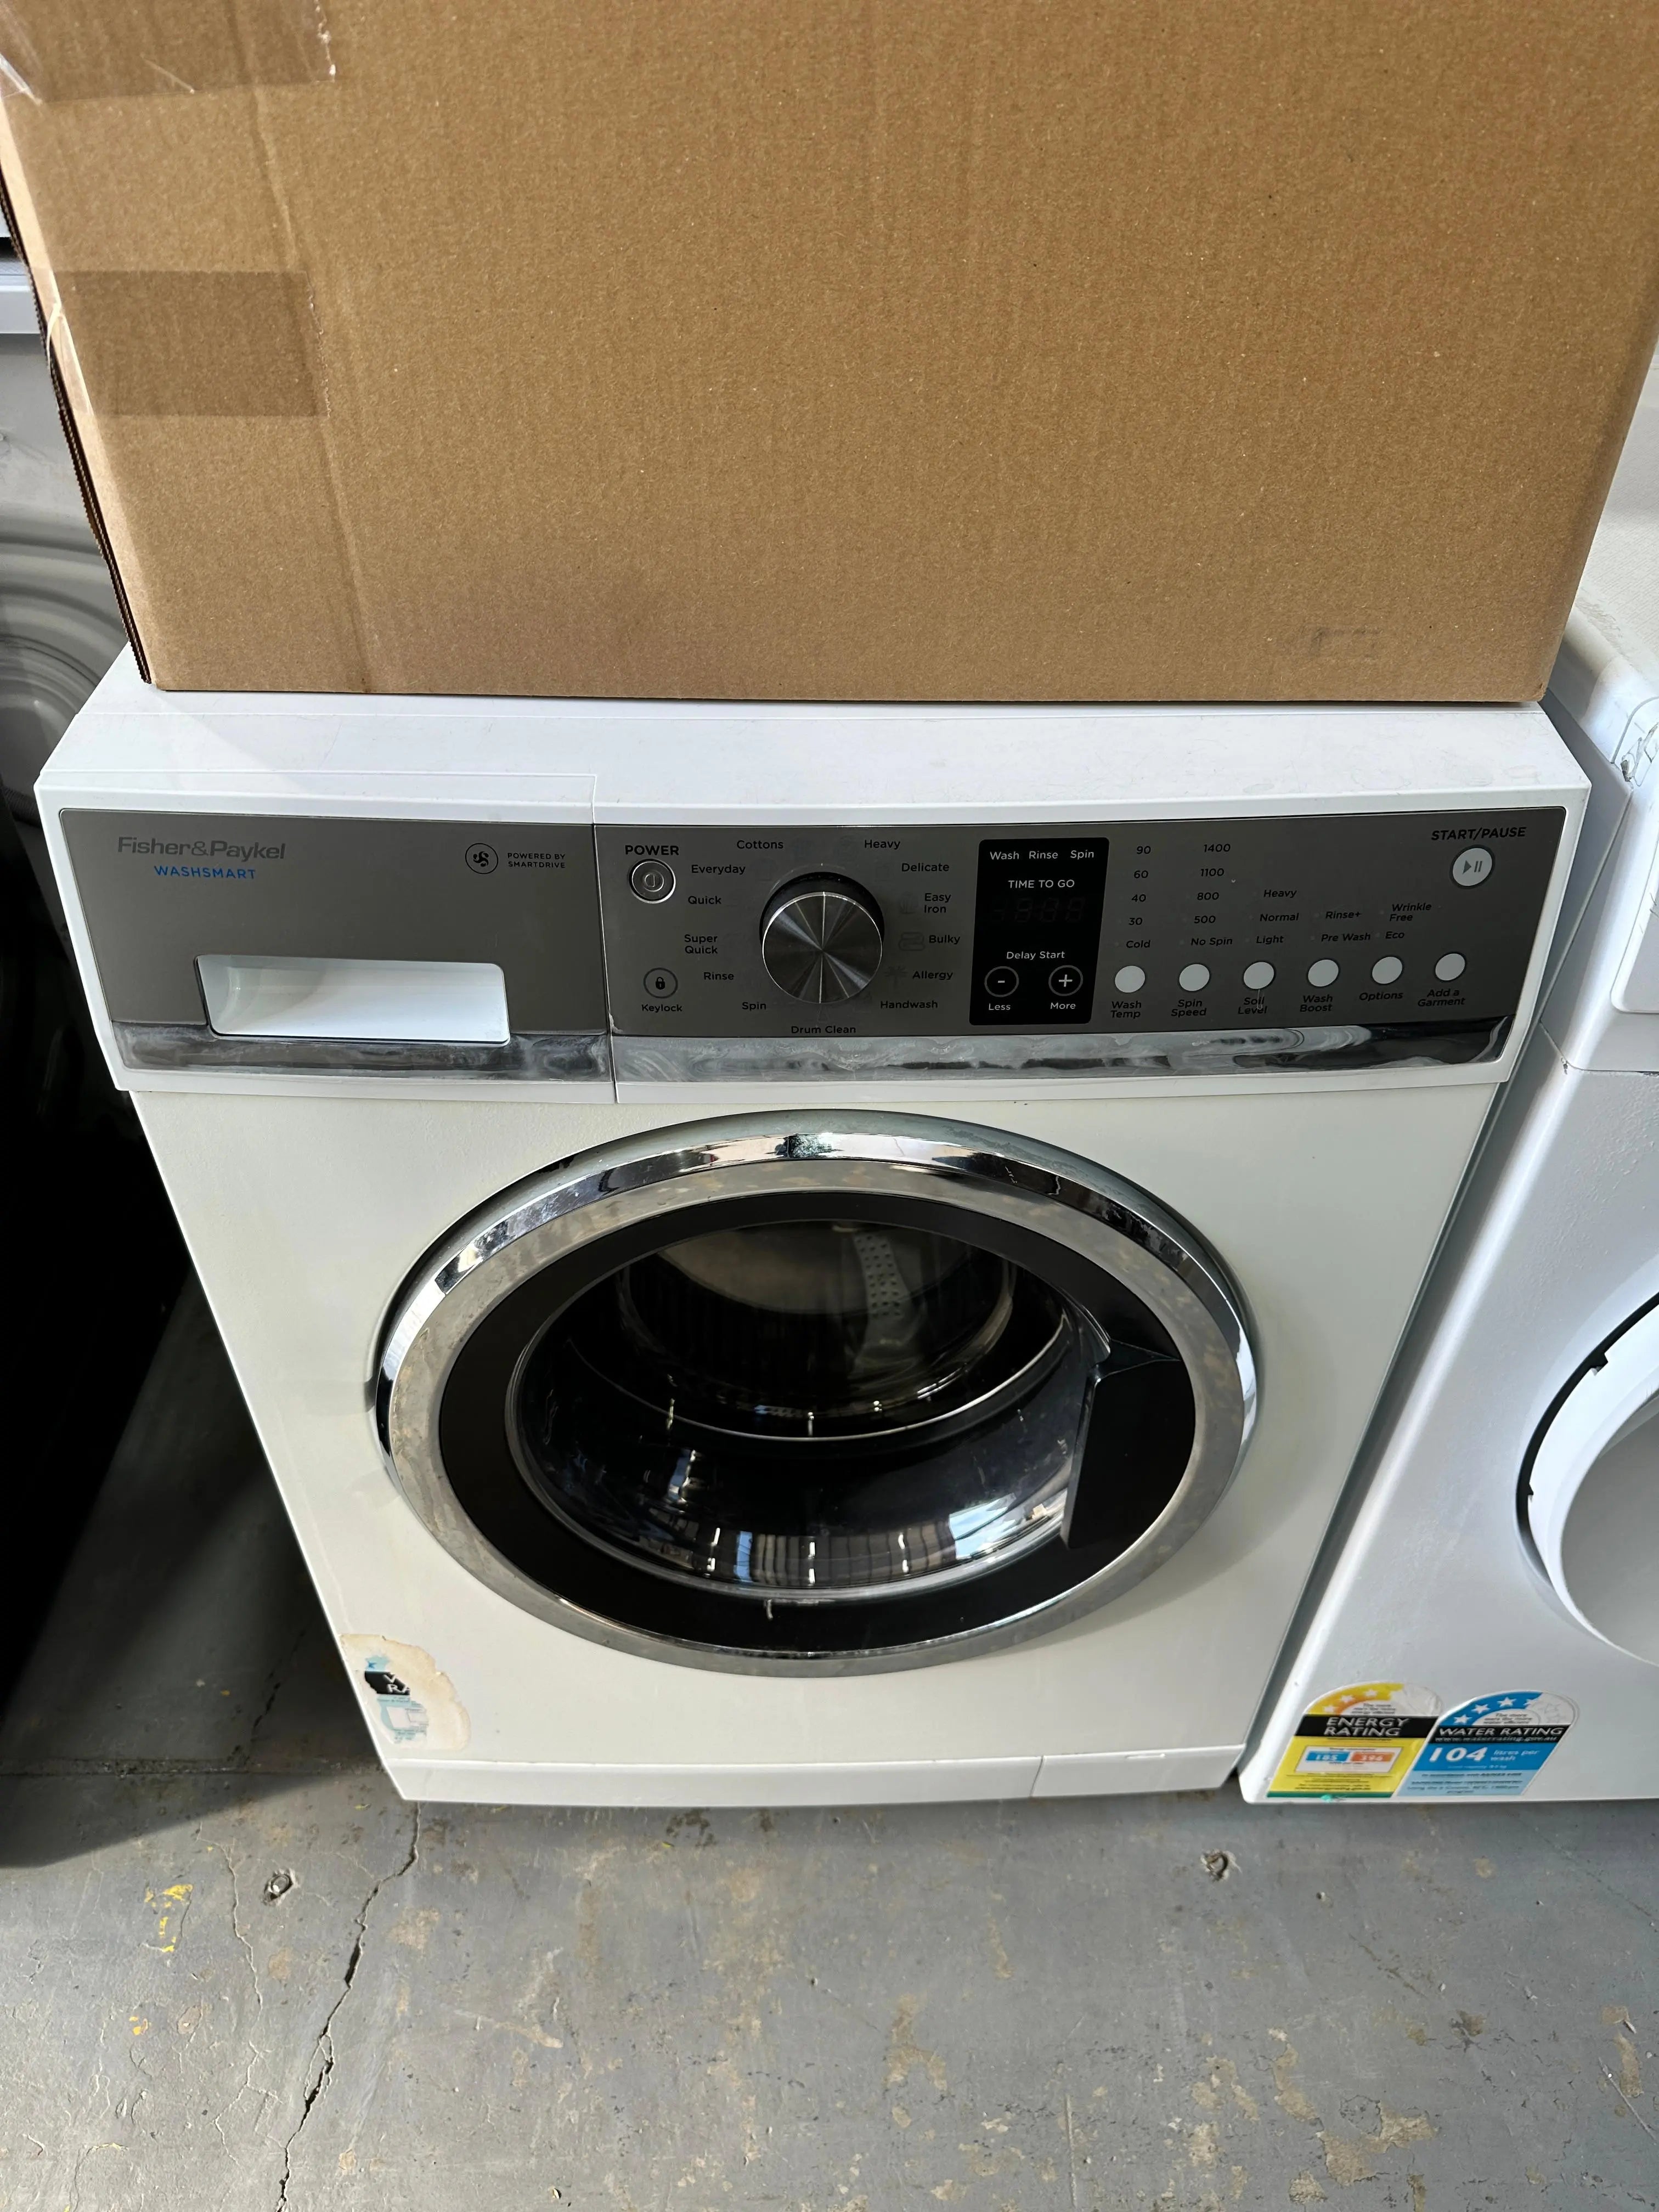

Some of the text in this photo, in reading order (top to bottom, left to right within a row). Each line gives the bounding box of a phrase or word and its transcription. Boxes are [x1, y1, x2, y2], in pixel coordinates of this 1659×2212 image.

[1431, 826, 1526, 841] START/PAUSE
[118, 837, 286, 862] Fisher&Paykel
[736, 840, 784, 849] Cottons
[864, 839, 901, 850] Heavy
[1136, 845, 1151, 854] 90
[1203, 844, 1231, 853] 1400
[625, 845, 680, 856] POWER
[990, 851, 1019, 860] Wash
[1029, 850, 1058, 859] Rinse
[1070, 850, 1095, 860] Spin
[154, 865, 256, 879] WASHSMART
[691, 864, 746, 875] Everyday
[901, 862, 950, 872] Delicate
[1133, 870, 1149, 879] 60
[1200, 868, 1224, 877] 1100
[1008, 879, 1075, 889] TIME TO GO
[924, 893, 951, 903] Easy
[1131, 894, 1147, 902] 40
[1197, 892, 1220, 901] 800
[1263, 889, 1297, 899] Heavy
[687, 896, 722, 906] Quick
[924, 904, 947, 913] Iron
[1391, 902, 1432, 912] Wrinkle
[1194, 915, 1216, 924] 500
[1260, 912, 1299, 922] Normal
[1325, 910, 1362, 920] Rinse+
[1389, 913, 1413, 922] Free
[1128, 917, 1143, 926] 30
[684, 934, 718, 945] Super
[928, 934, 961, 946] Bulky
[1256, 935, 1284, 945] Light
[1321, 933, 1371, 943] Pre Wash
[1385, 931, 1405, 939] Eco
[1126, 939, 1151, 949] Cold
[1190, 936, 1233, 947] No Spin
[684, 945, 718, 955] Quick
[1006, 951, 1065, 961] Delay Start
[703, 972, 735, 981] Rinse
[912, 970, 953, 981] Allergy
[1359, 991, 1403, 1001] Options
[1427, 989, 1449, 997] Add
[1177, 999, 1203, 1009] Spin
[1243, 997, 1265, 1006] Soil
[1302, 994, 1333, 1004] Wash
[1417, 997, 1465, 1008] Garment
[641, 1003, 682, 1014] Keylock
[742, 1001, 767, 1012] Spin
[880, 1000, 938, 1009] Handwash
[988, 1003, 1011, 1011] Less
[1050, 1002, 1076, 1011] More
[1111, 1000, 1142, 1009] Wash
[1300, 1003, 1332, 1013] Boost
[1110, 1009, 1141, 1019] Temp
[1171, 1008, 1207, 1017] Speed
[1238, 1006, 1268, 1015] Level
[791, 1025, 856, 1034] Drum Clean
[1327, 1717, 1409, 1727] ENERGY
[1323, 1727, 1401, 1736] RATING
[1439, 1727, 1564, 1736] WATER RATING
[1429, 1746, 1488, 1762] 104
